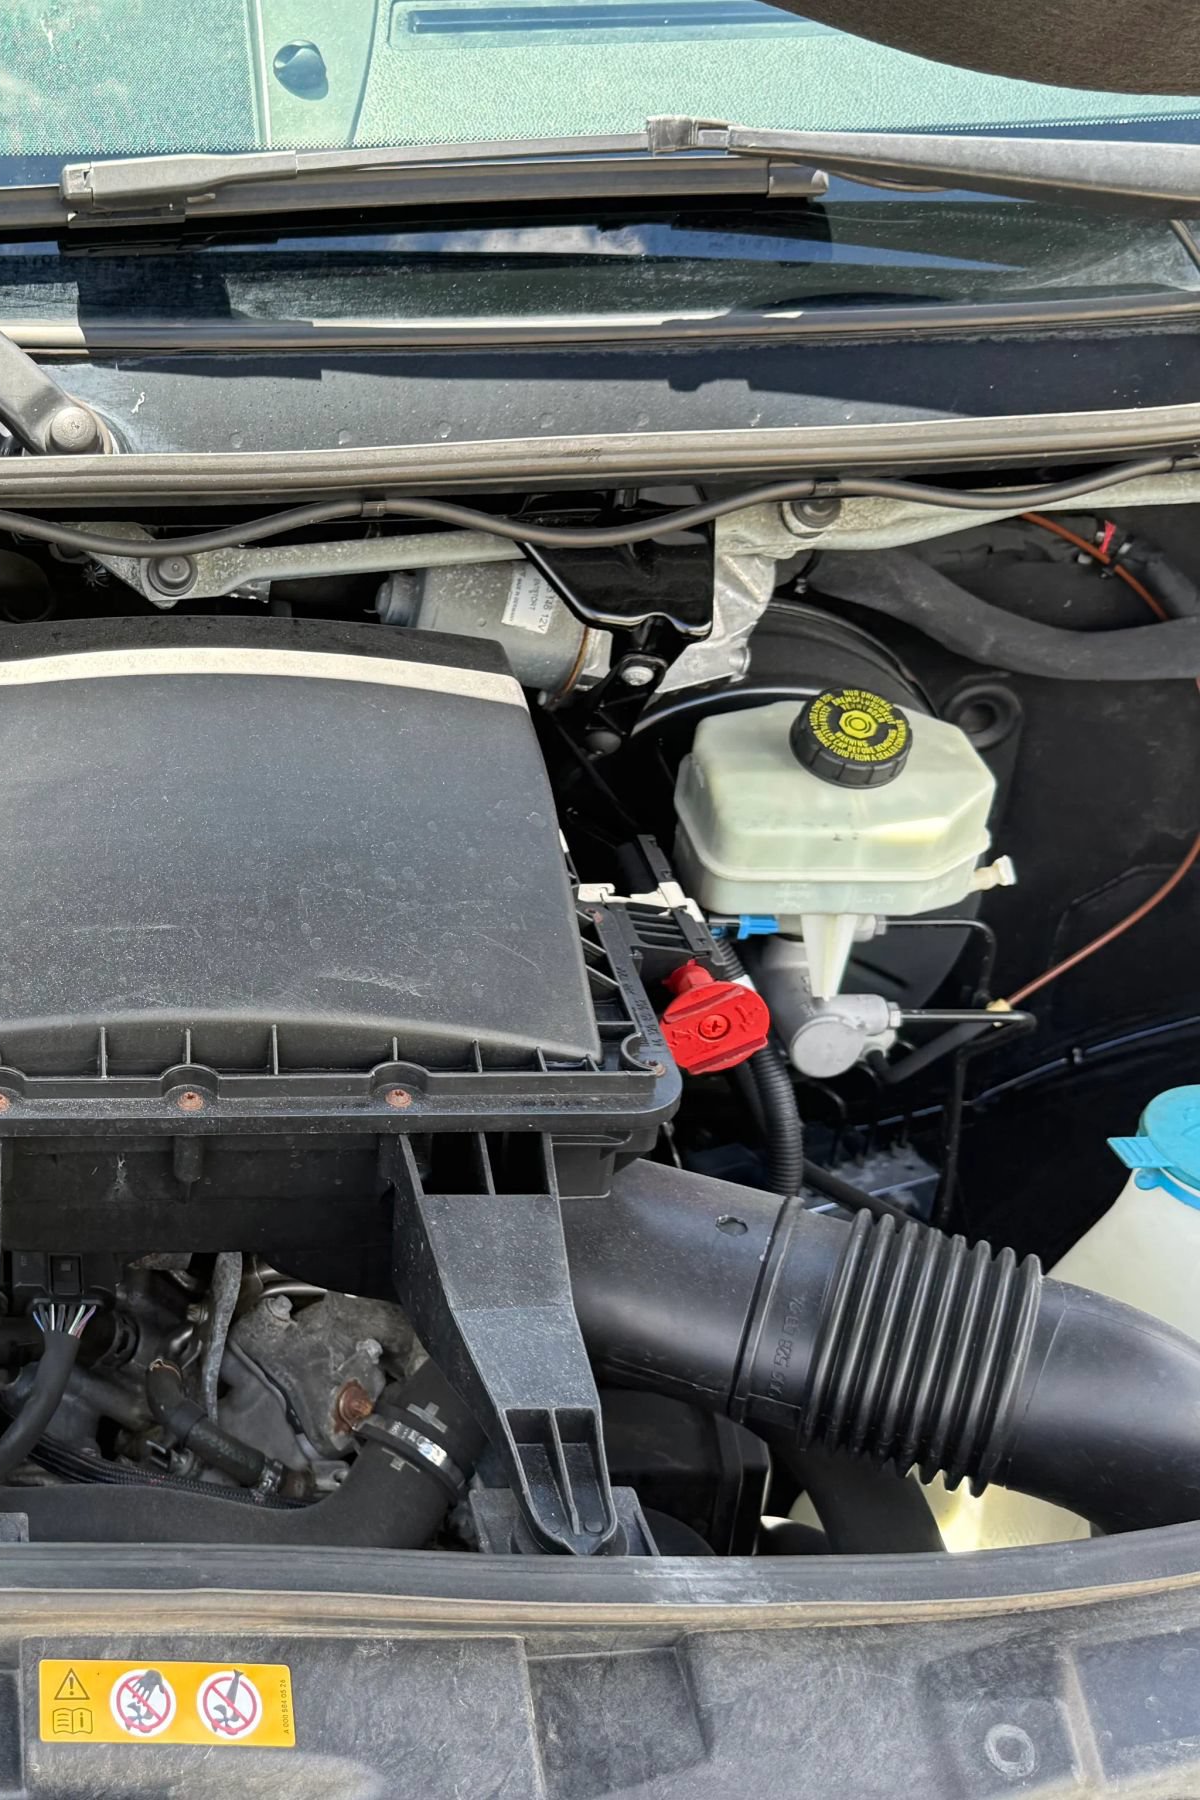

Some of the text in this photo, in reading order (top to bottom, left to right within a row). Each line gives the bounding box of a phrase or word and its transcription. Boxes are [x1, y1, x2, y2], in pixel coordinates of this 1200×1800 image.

[813, 730, 832, 747] BRAKE
[830, 745, 850, 758] FLUID
[850, 753, 871, 761] FROM
[819, 722, 835, 740] FILLER
[833, 739, 848, 750] CAP
[847, 745, 875, 754] BEFORE
[835, 731, 869, 747] WARNING
[281, 1689, 287, 1698] 05
